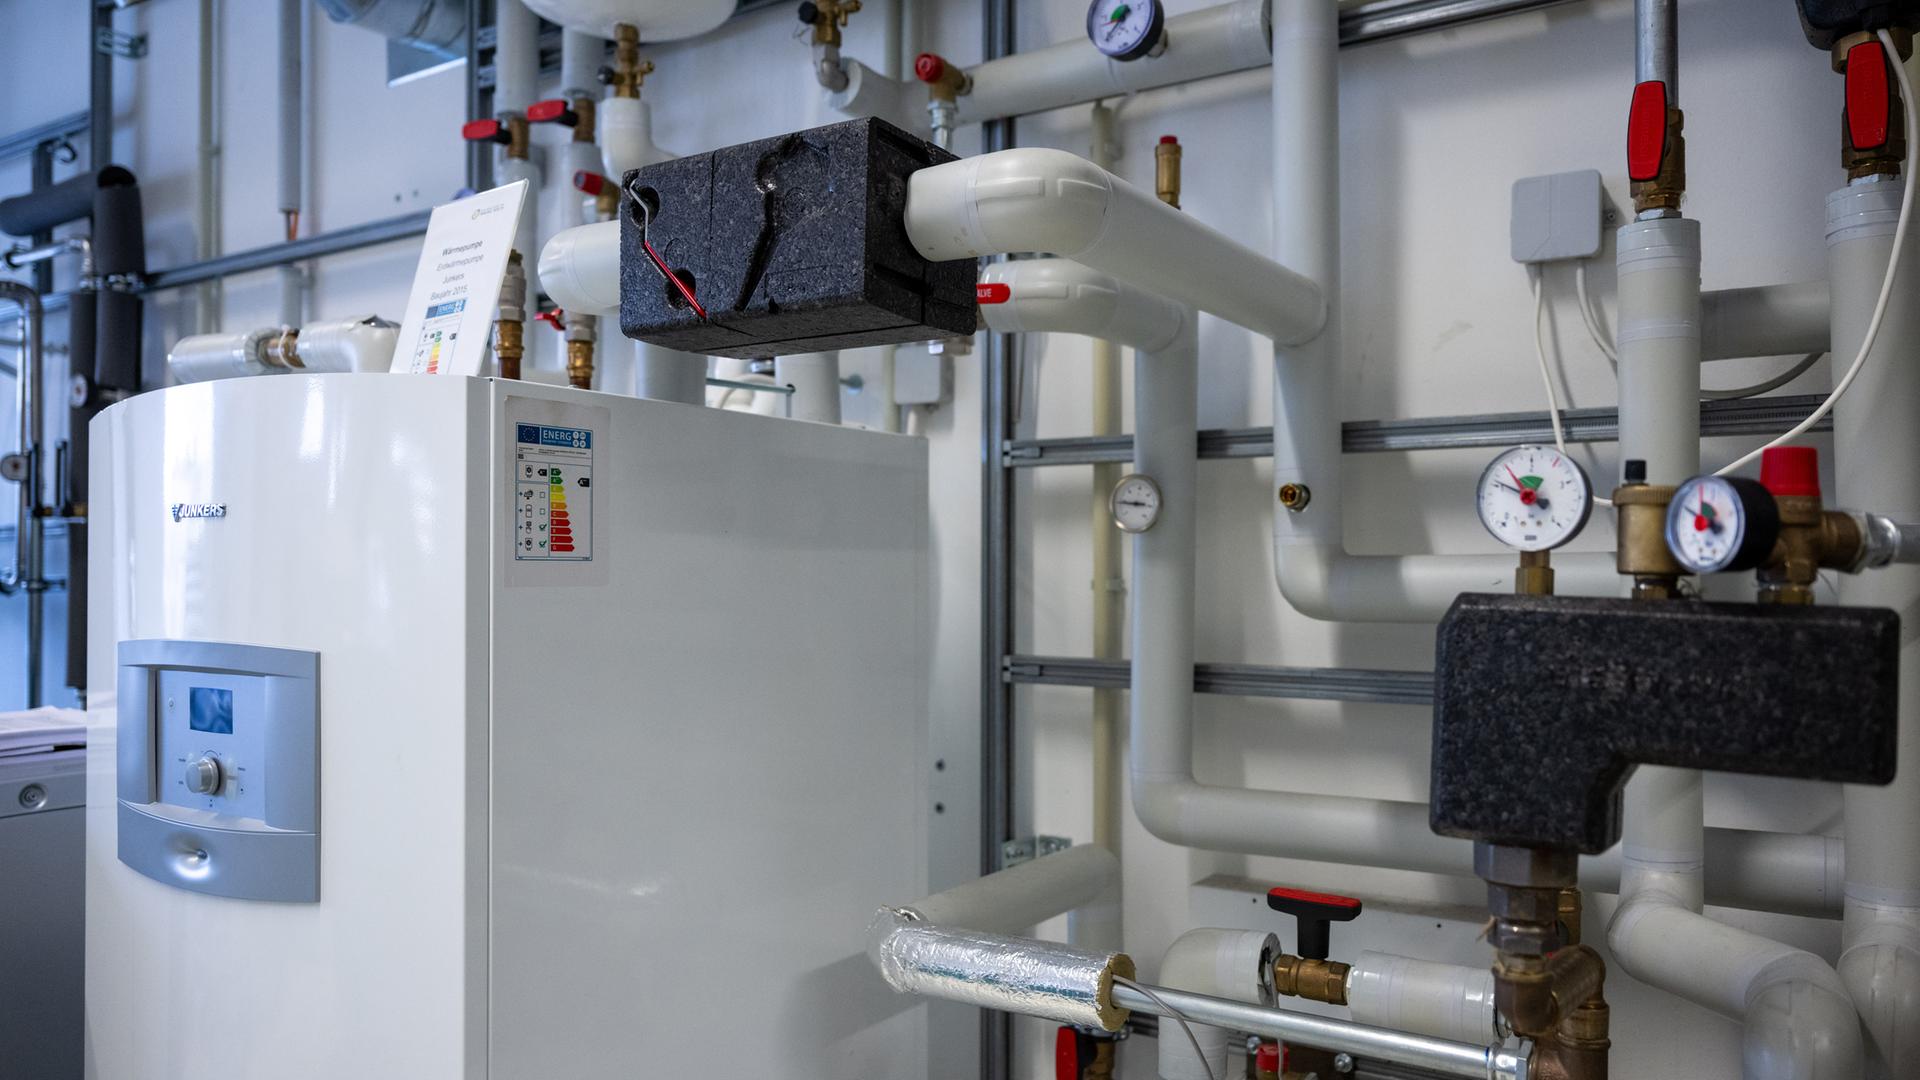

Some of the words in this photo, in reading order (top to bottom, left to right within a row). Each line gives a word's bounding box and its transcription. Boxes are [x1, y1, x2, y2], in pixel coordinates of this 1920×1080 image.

[442, 240, 483, 257] Wärmepumpe
[443, 272, 465, 284] Junkers
[430, 289, 452, 301] Baujahr
[452, 284, 468, 296] 2015
[543, 429, 572, 441] ENERG
[178, 503, 226, 518] JUNKERS
